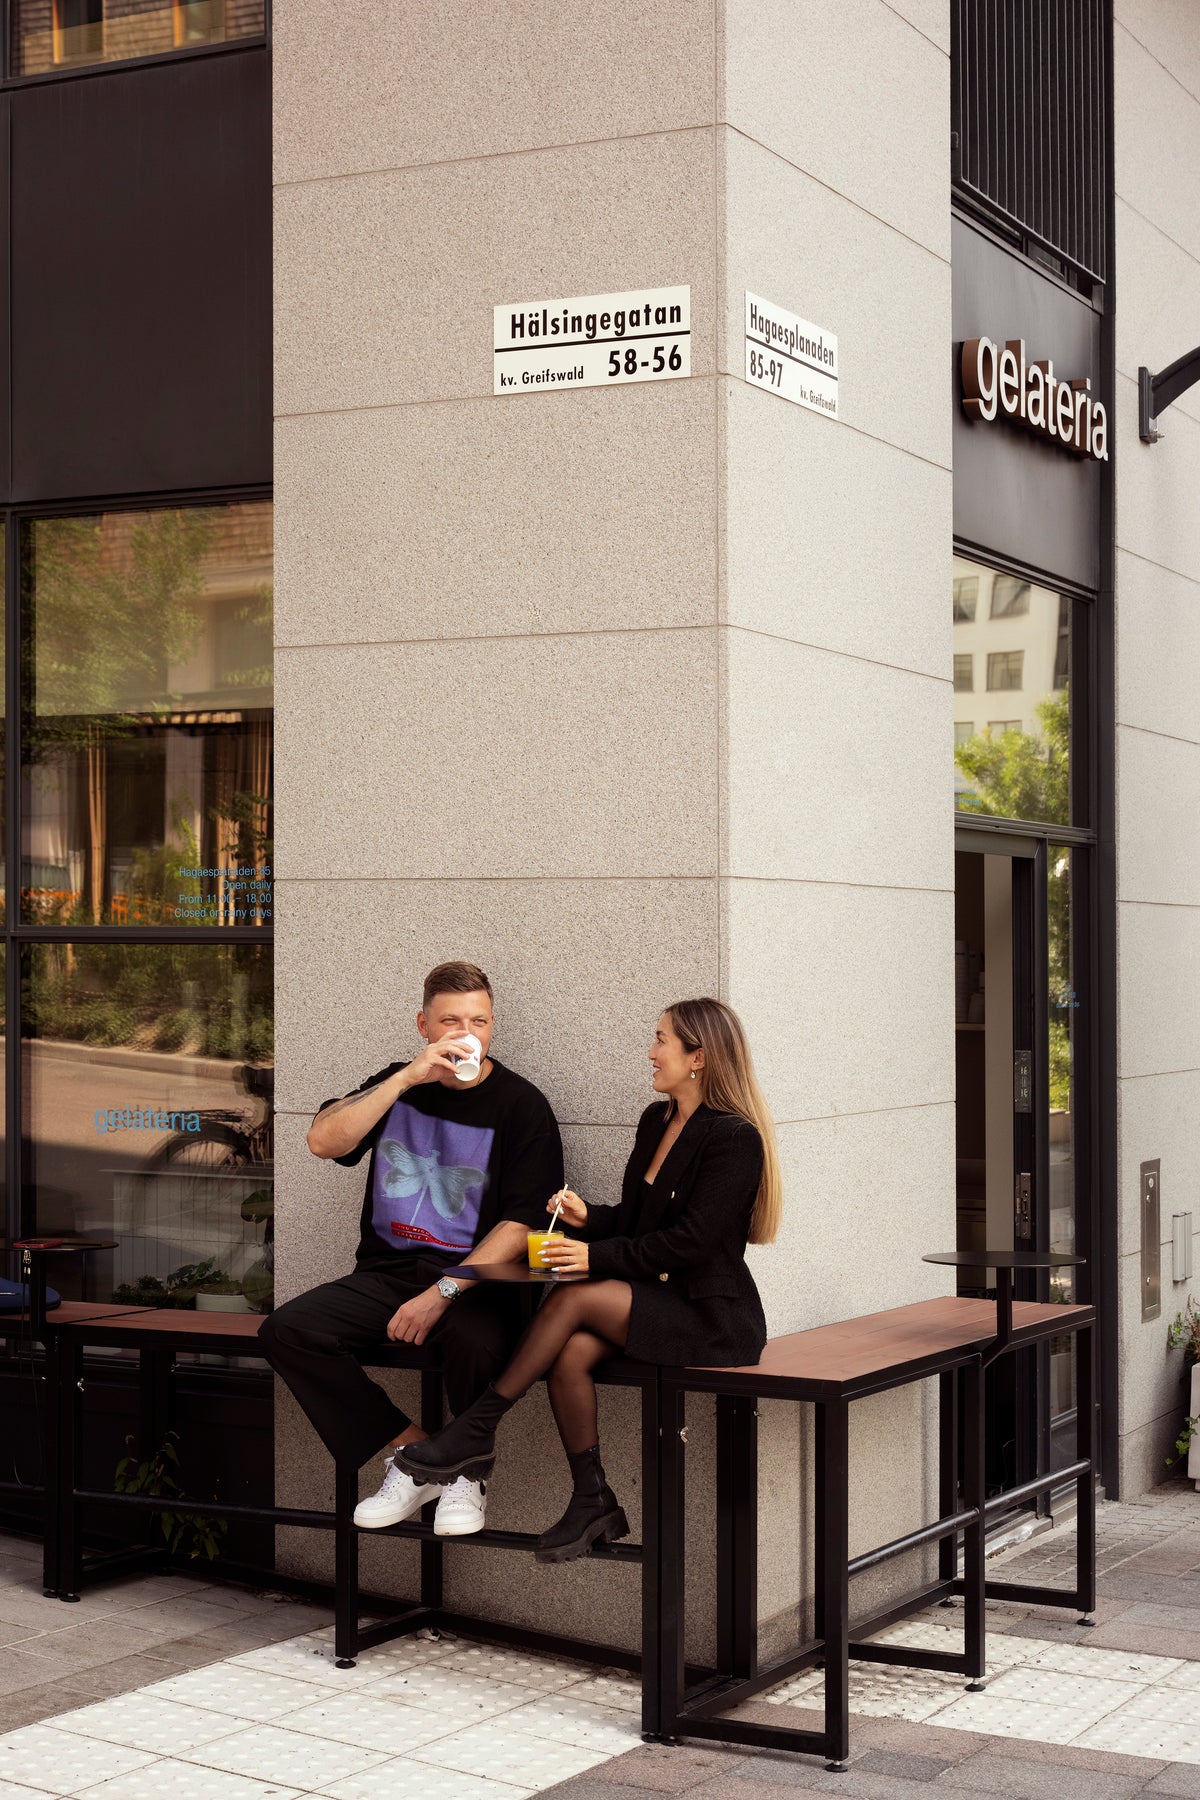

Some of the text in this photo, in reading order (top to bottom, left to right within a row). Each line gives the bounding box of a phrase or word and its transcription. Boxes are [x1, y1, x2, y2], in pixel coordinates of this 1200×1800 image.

[511, 304, 682, 339] Hälsingegatan
[750, 303, 834, 367] Hagaesplanaden
[608, 344, 682, 376] 58-56
[750, 350, 783, 387] 85-97
[500, 365, 584, 386] kv. Greifswald
[800, 384, 836, 413] kv. Greifswald
[976, 336, 1109, 461] gelateria
[179, 893, 203, 904] From
[222, 880, 272, 891] Open daily
[174, 907, 272, 919] Closed on rainy days
[94, 1104, 201, 1134] gelateria
